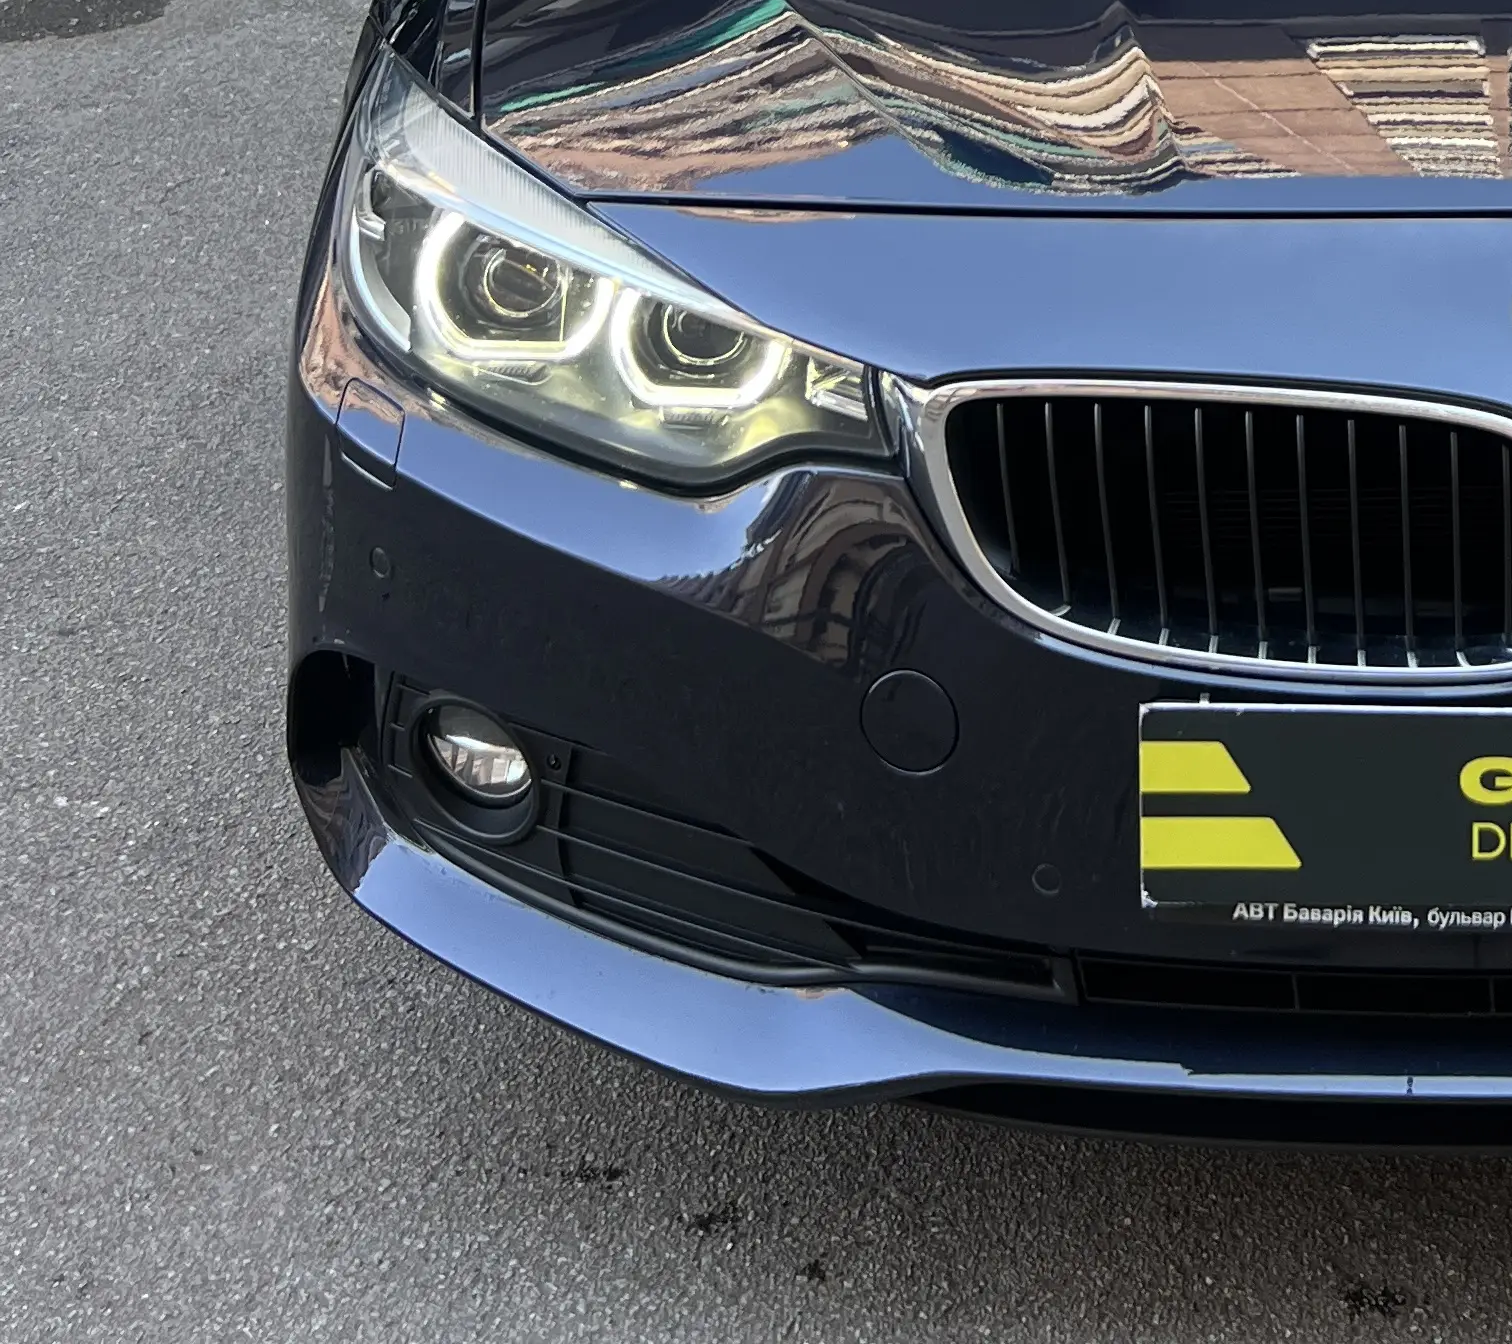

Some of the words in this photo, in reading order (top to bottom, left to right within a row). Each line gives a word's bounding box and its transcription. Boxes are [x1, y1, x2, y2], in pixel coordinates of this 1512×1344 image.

[1232, 901, 1279, 922] АВТ
[1283, 902, 1364, 928] Баварія
[1368, 905, 1420, 929] Київ,
[1427, 906, 1507, 930] бульвар
